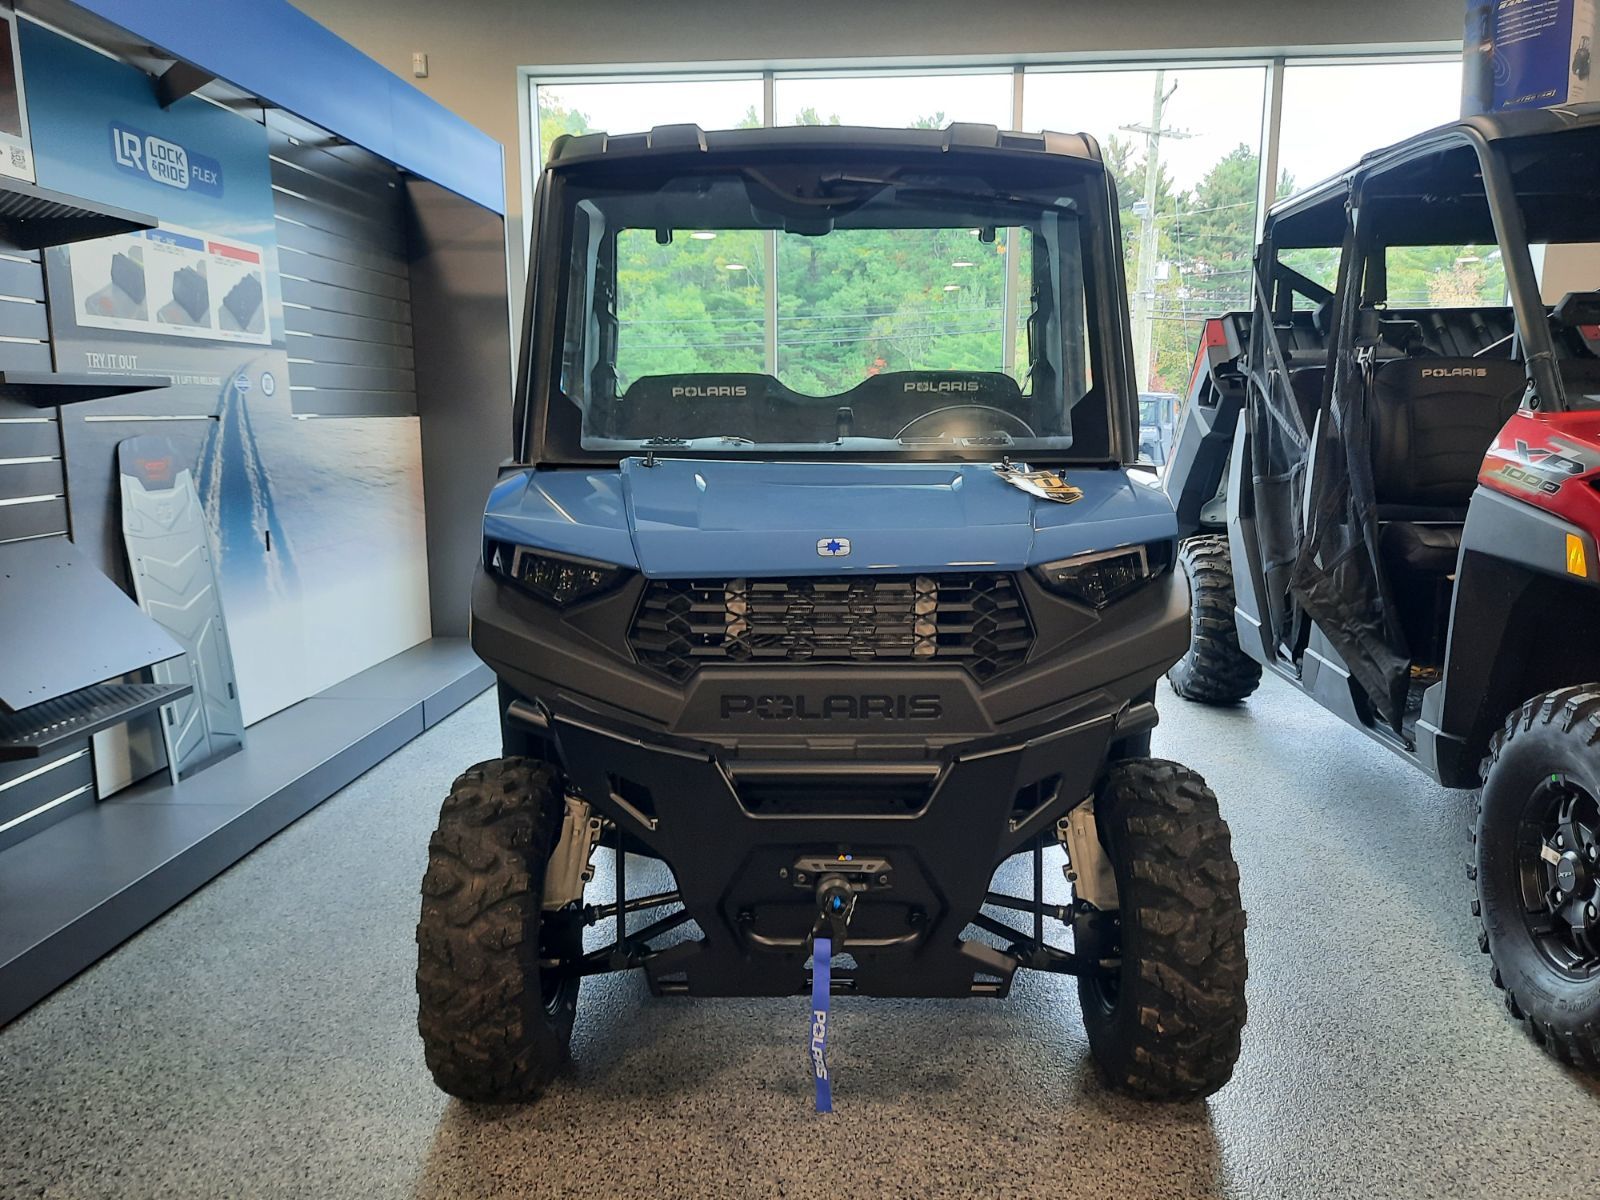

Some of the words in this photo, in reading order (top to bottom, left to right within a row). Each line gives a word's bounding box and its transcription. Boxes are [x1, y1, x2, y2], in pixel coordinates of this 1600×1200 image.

[149, 141, 184, 167] LOCK
[192, 166, 217, 185] FLEX
[86, 352, 104, 368] TRY
[107, 354, 117, 369] IT
[119, 355, 137, 370] OUT
[1421, 368, 1487, 378] POLARIS
[672, 386, 747, 398] POLARIS
[904, 381, 979, 392] POLARIS
[1515, 438, 1585, 476] XP
[1500, 464, 1562, 496] 1000
[720, 695, 943, 720] POLARIS
